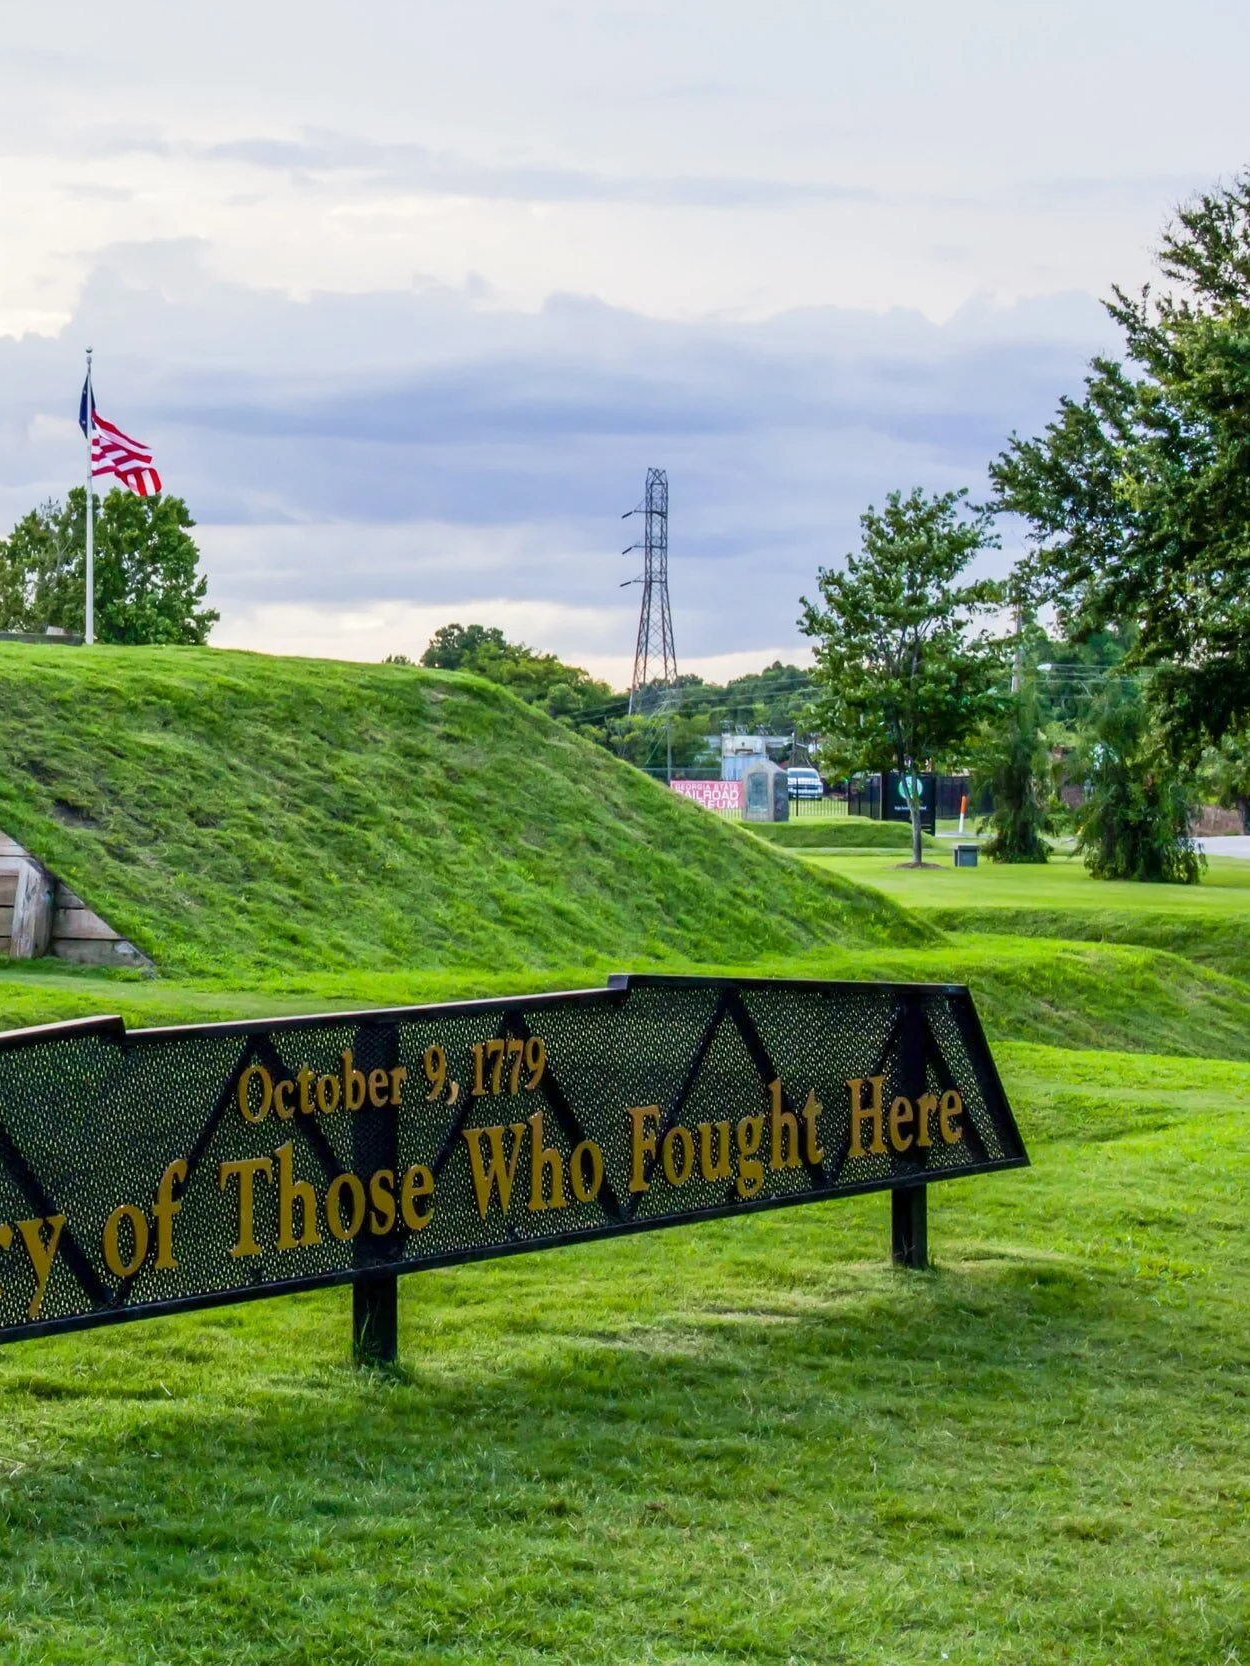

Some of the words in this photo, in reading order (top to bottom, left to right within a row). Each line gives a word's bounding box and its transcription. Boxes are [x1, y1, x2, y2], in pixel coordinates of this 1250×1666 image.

[675, 783, 711, 791] GEORGIA
[713, 783, 739, 791] STATE
[238, 1053, 403, 1123] October
[423, 1044, 459, 1107] 9,
[472, 1037, 547, 1097] 1779
[103, 1159, 189, 1278] of
[220, 1141, 435, 1258] Those
[462, 1113, 603, 1221] Who
[628, 1078, 824, 1198] Fought
[846, 1074, 964, 1159] Here
